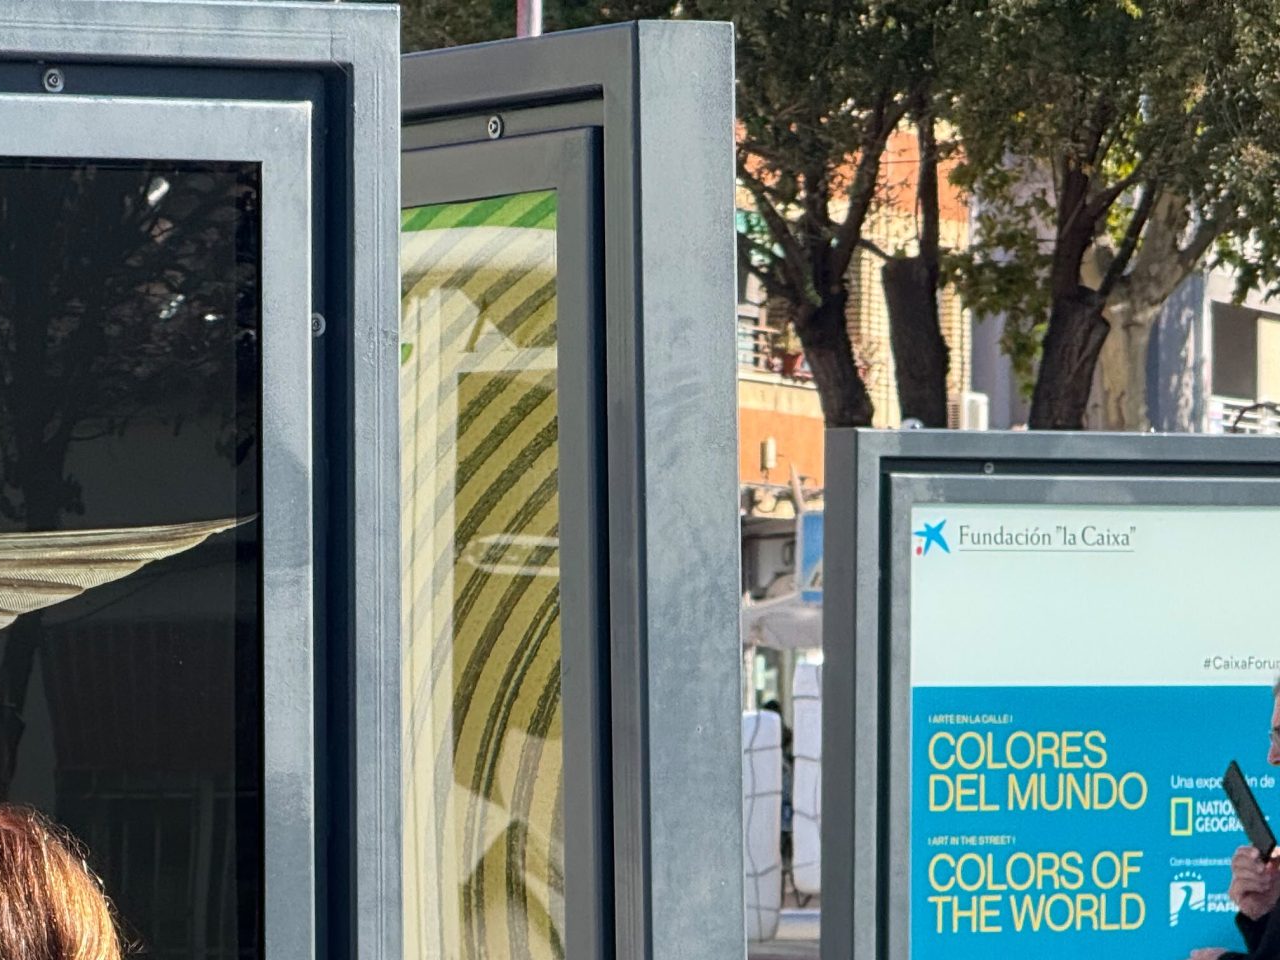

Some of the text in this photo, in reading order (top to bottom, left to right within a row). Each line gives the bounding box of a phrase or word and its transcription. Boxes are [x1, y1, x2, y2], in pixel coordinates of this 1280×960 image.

[959, 524, 1051, 546] Fundación
[956, 714, 969, 724] EN
[970, 714, 980, 724] LA
[928, 731, 1107, 770] COLORES
[928, 771, 1148, 812] DEL MUNDO
[1171, 775, 1194, 789] Una
[1260, 774, 1276, 789] de
[932, 835, 1011, 846] ART IN THE STREET
[928, 851, 1144, 892] COLORS OF
[928, 892, 1146, 933] THE WORLD
